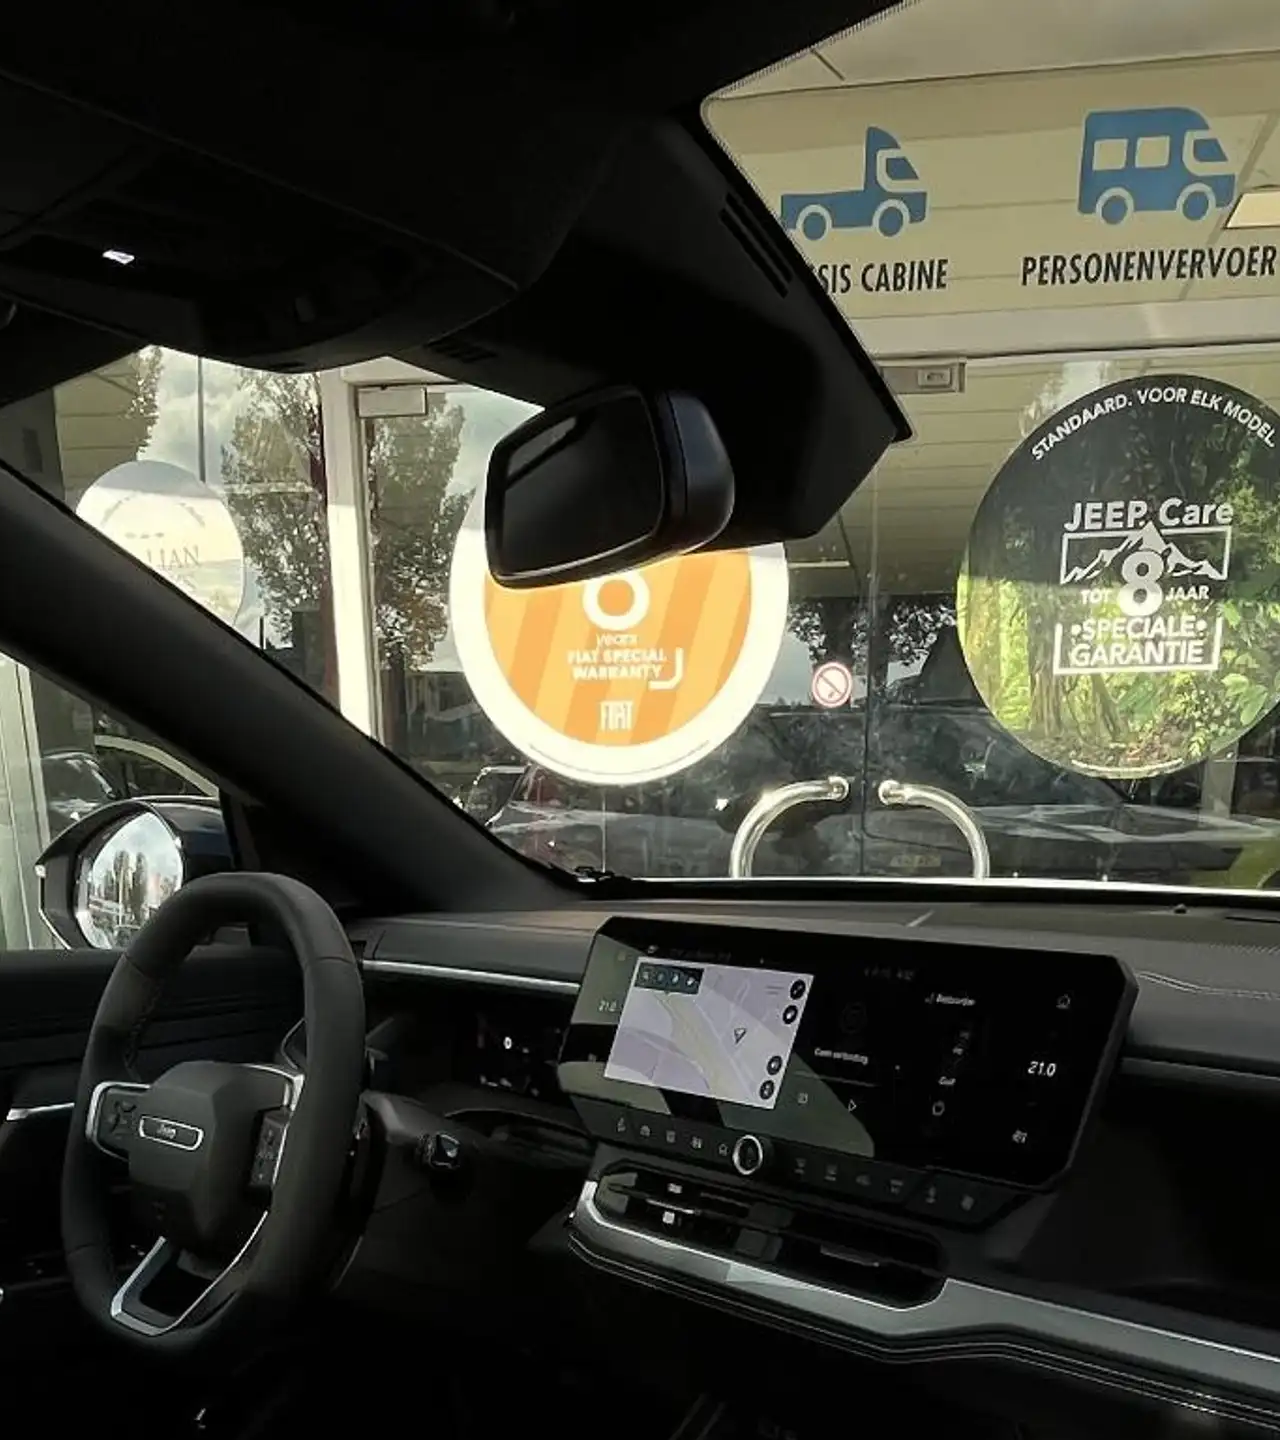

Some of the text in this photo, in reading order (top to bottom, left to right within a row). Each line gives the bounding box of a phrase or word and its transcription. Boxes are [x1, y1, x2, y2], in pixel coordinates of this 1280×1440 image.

[860, 258, 948, 293] CABINE
[1021, 245, 1277, 286] PERSONENVERVOER
[1136, 387, 1187, 406] VOOR
[1190, 389, 1221, 411] ELK
[1159, 497, 1234, 526] Care
[1080, 550, 1210, 617] TOT 8 JAAR
[566, 647, 667, 664] FIAT SPECIAL
[1071, 640, 1204, 667] GARANTIE
[572, 664, 662, 681] WARRANTY
[1027, 1059, 1058, 1078] 21.0
